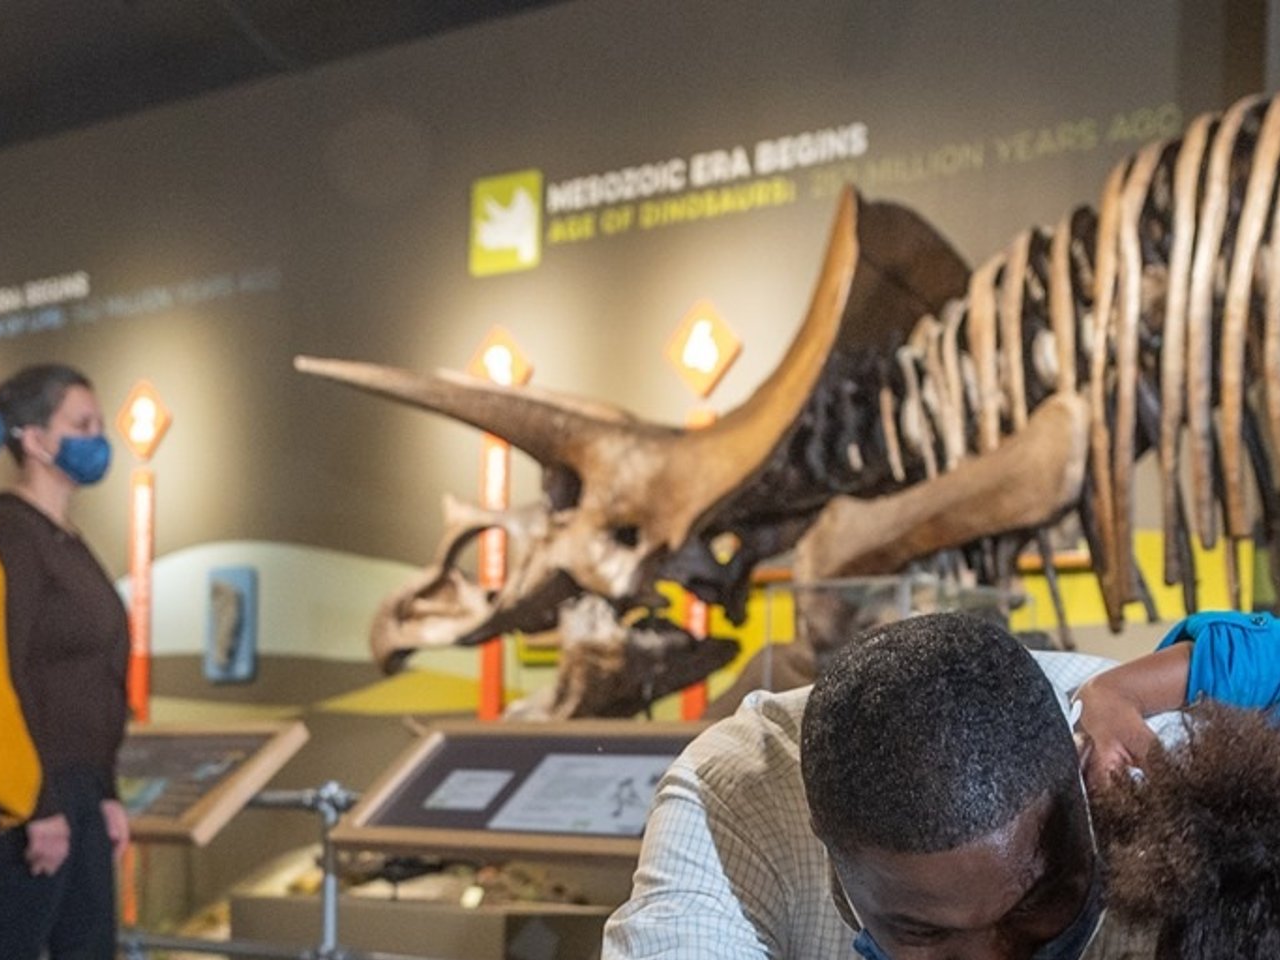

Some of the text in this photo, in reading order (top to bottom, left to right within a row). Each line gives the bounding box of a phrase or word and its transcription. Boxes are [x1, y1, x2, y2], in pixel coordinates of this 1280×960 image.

[546, 157, 687, 214] MESOZOIC
[690, 145, 751, 187] ERA
[754, 121, 869, 175] BEGINS
[548, 211, 595, 243] AGE
[600, 204, 631, 234] OF
[995, 116, 1098, 164] YEARS
[1106, 101, 1184, 143] AGO
